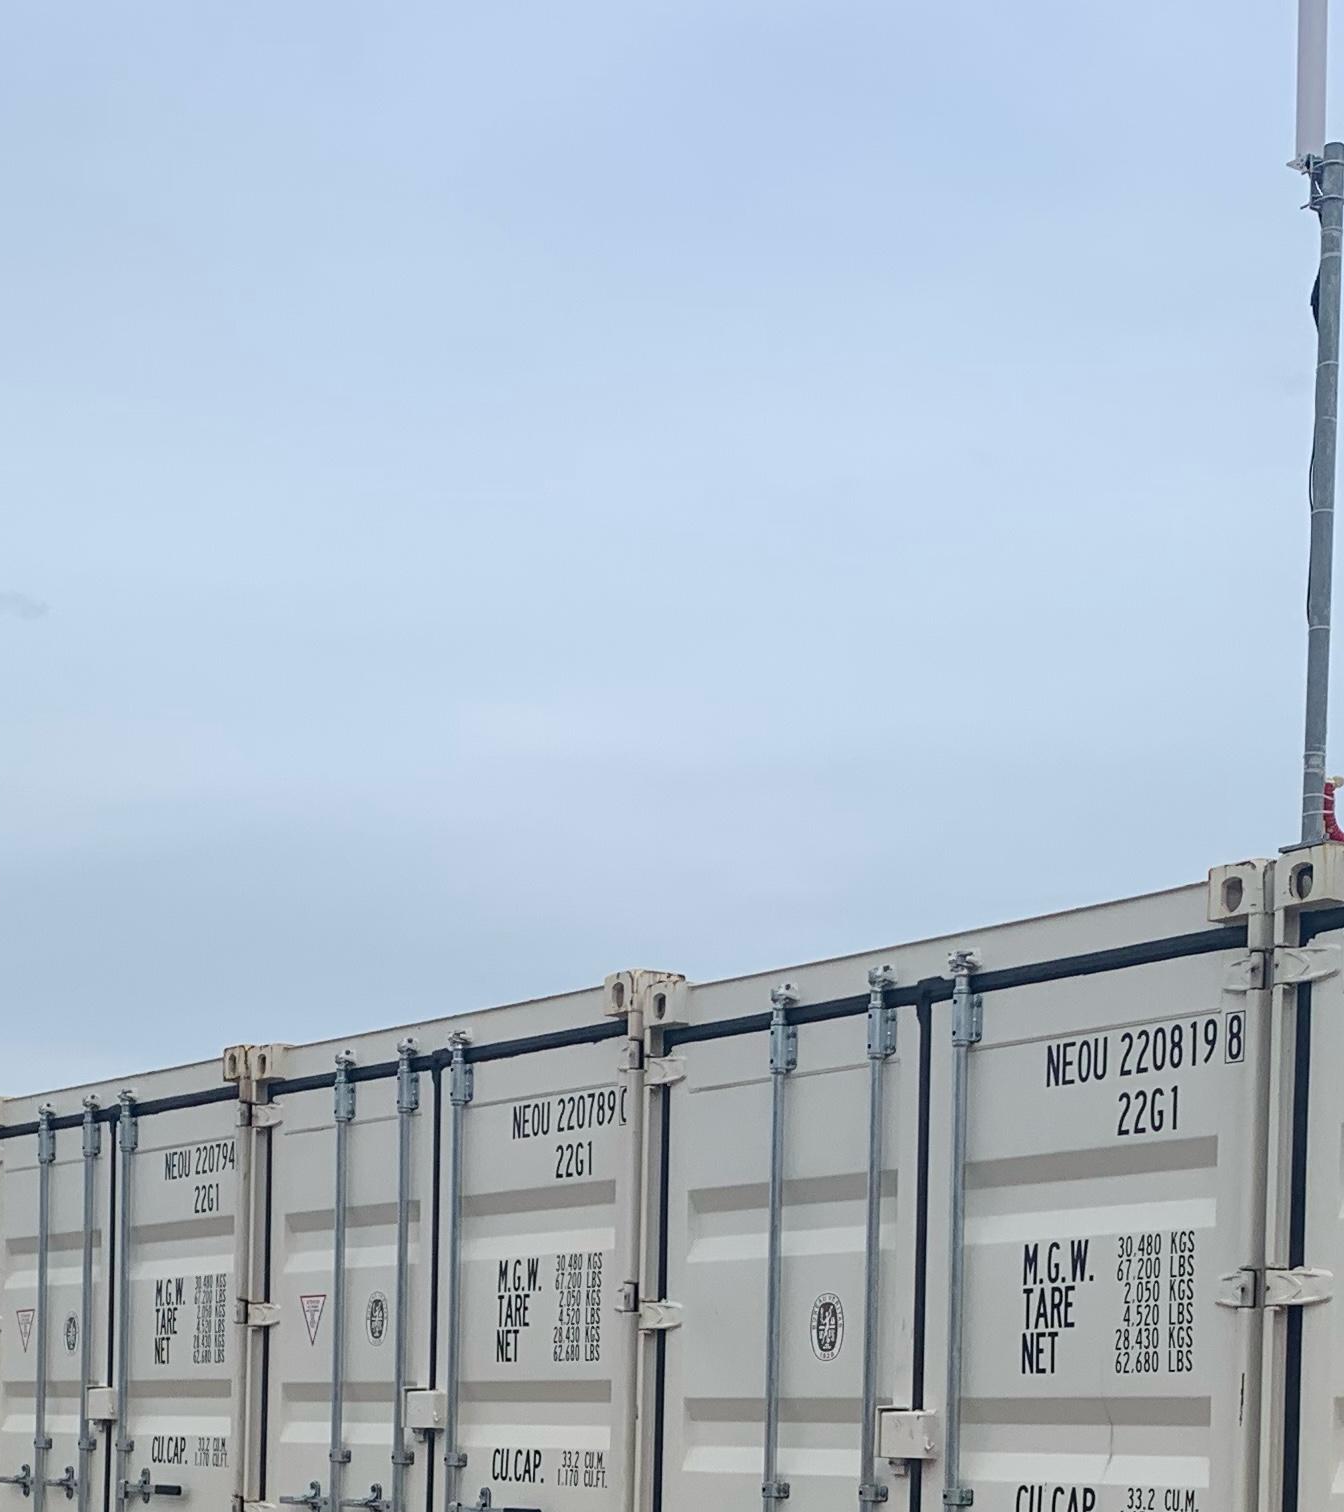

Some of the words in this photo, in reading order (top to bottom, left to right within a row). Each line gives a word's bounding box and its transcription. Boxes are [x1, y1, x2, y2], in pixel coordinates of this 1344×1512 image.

[1046, 1036, 1108, 1088] NEOU
[1120, 1018, 1218, 1077] 220819
[512, 1101, 551, 1140] NEOU
[557, 1090, 616, 1132] 220789
[1117, 1085, 1179, 1136] 22G1
[165, 1150, 191, 1180] NEOU
[195, 1141, 235, 1175] 220794
[555, 1141, 592, 1178] 22G1
[194, 1183, 219, 1213] 22G1
[1170, 1230, 1195, 1254] KGS
[587, 1252, 603, 1270] KGS
[1023, 1239, 1094, 1285] M.G.W.
[1169, 1254, 1195, 1278] LBS
[498, 1258, 542, 1293] M.G.W.
[586, 1271, 602, 1288] LBS
[155, 1277, 185, 1307] M.G.W.
[586, 1289, 601, 1306] KGS
[1169, 1278, 1194, 1302] KGS
[156, 1307, 178, 1335] TARE
[497, 1294, 530, 1327] TARE
[585, 1307, 600, 1325] LBS
[1023, 1285, 1076, 1330] TARE
[1168, 1302, 1193, 1325] LBS
[496, 1329, 520, 1362] NET
[585, 1326, 600, 1343] KGS
[1168, 1326, 1193, 1349] KGS
[154, 1337, 171, 1364] NET
[584, 1344, 600, 1361] LBS
[1021, 1331, 1059, 1374] NET
[1168, 1349, 1193, 1373] LBS
[152, 1436, 188, 1464] CU.CAP.
[562, 1450, 580, 1468] 33.2
[492, 1448, 544, 1483] CU.CAP.
[1127, 1487, 1155, 1511] 33.2
[1164, 1488, 1199, 1512] CU.M.
